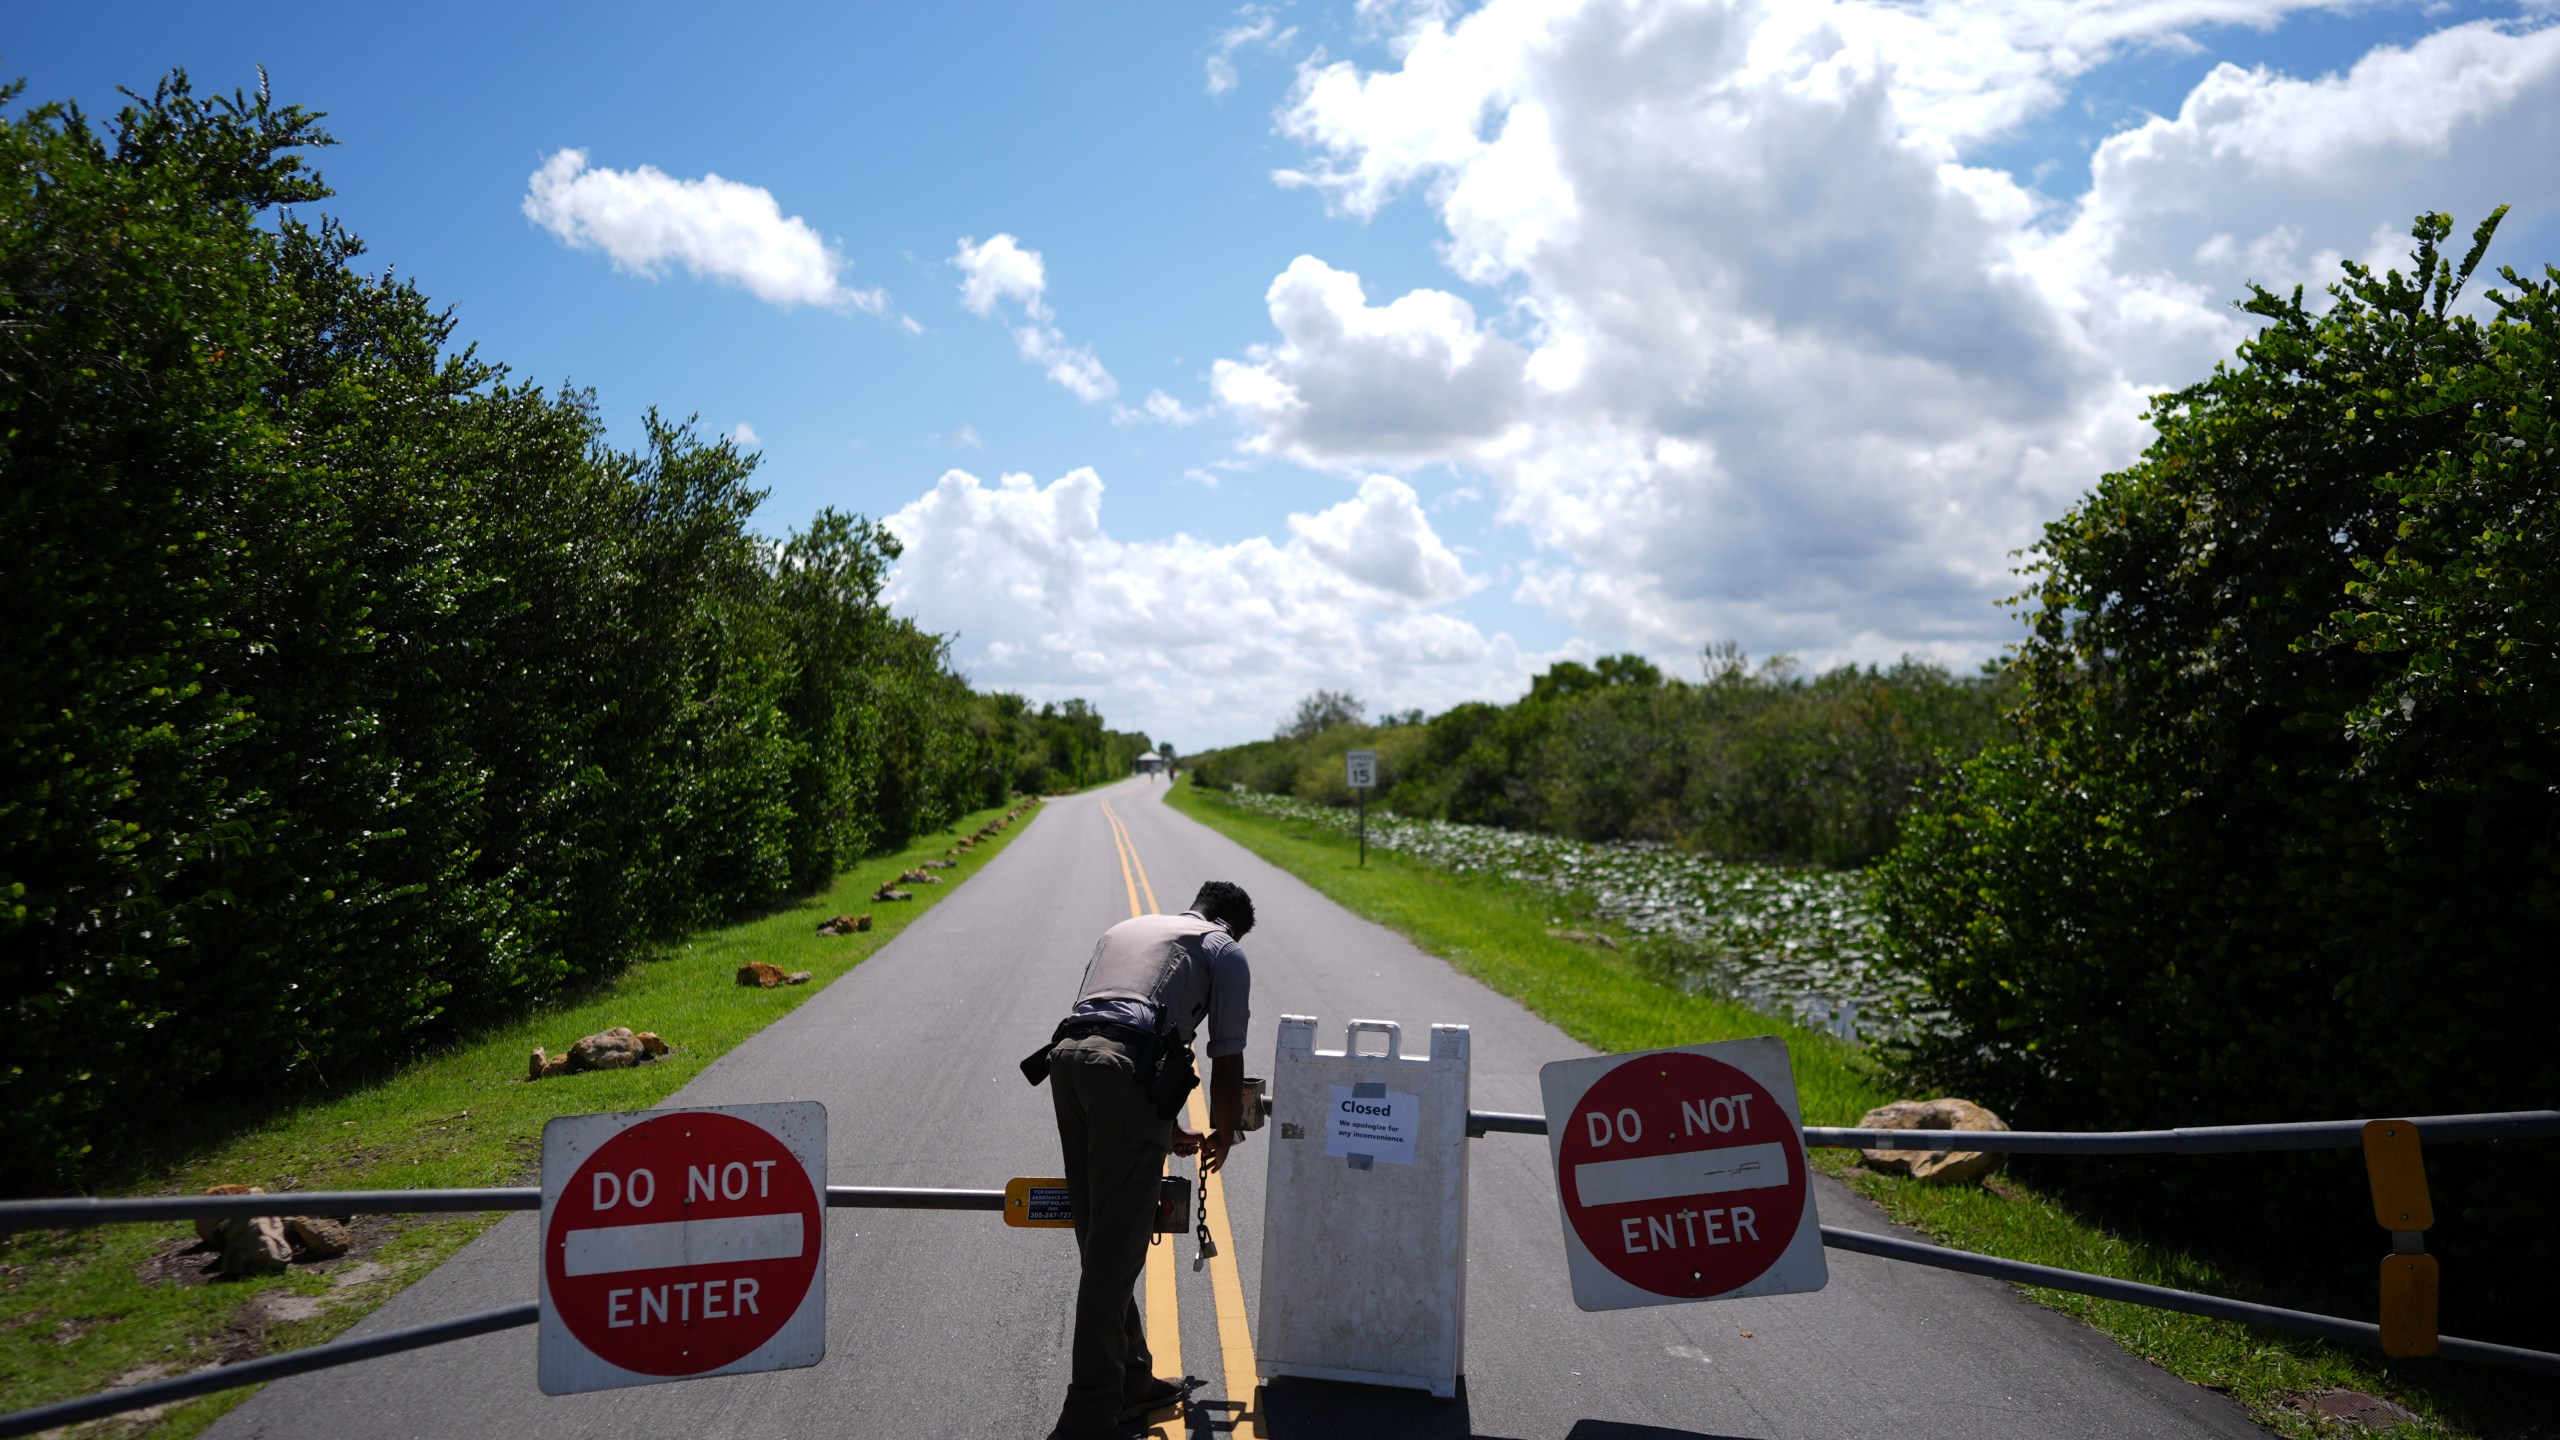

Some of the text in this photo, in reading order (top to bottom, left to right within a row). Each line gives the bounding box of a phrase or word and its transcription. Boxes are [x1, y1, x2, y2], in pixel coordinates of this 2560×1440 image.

[1353, 770, 1370, 784] 15
[1341, 1100, 1391, 1117] Closed
[1586, 1094, 1753, 1147] DO NOT
[1338, 1130, 1406, 1143] any inconvenience.
[1352, 1122, 1386, 1131] apologize
[593, 1160, 777, 1211] DO NOT
[1621, 1206, 1760, 1254] ENTER
[608, 1278, 759, 1328] ENTER
